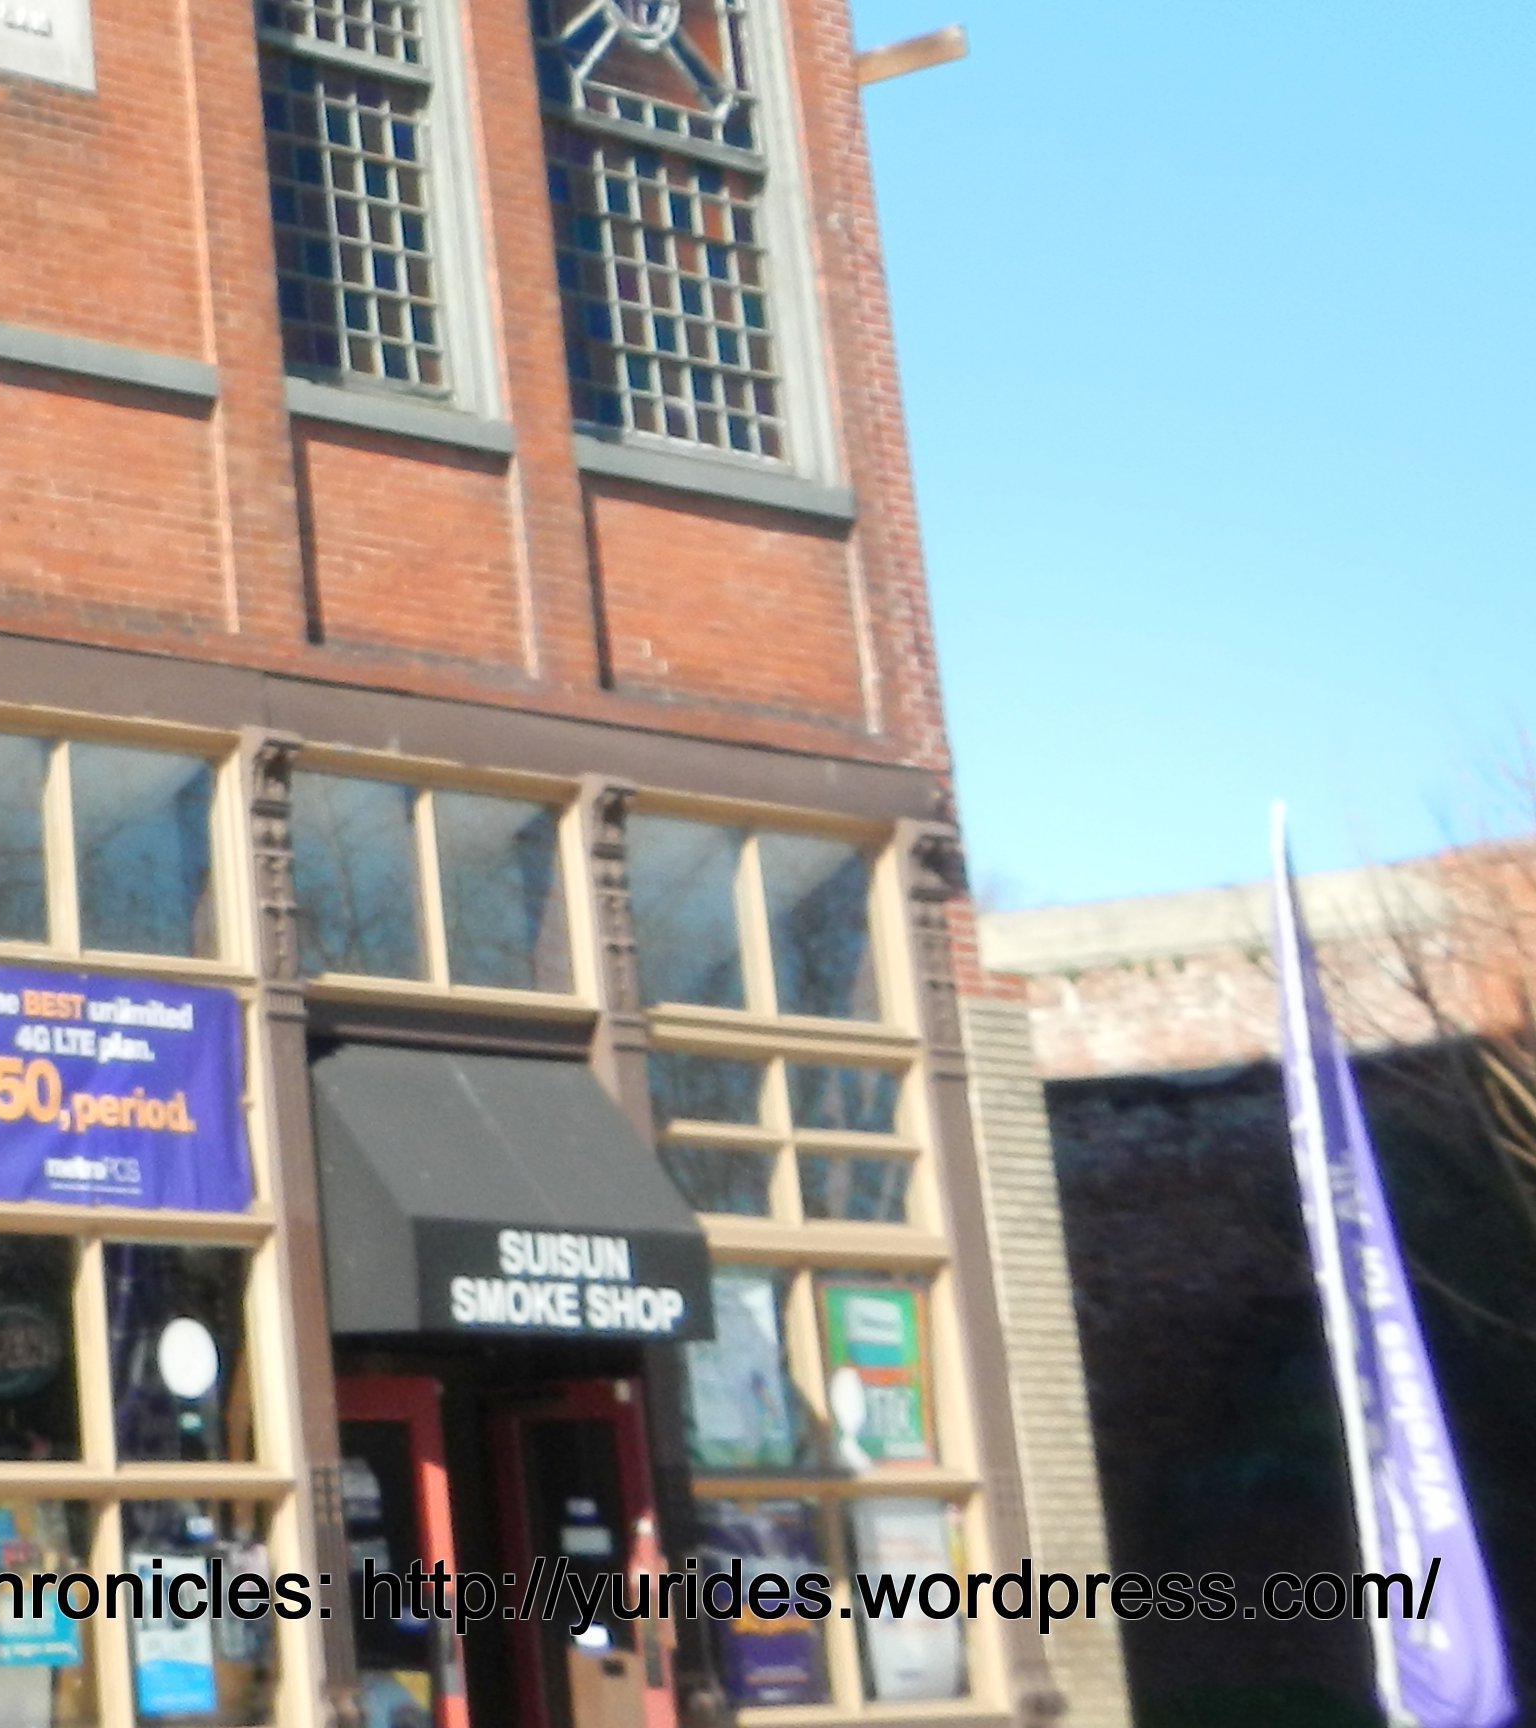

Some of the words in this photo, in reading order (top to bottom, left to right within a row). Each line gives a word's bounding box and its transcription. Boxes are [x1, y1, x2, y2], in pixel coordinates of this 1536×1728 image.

[22, 988, 85, 1019] BEST
[87, 996, 194, 1031] unlimited
[14, 1024, 51, 1053] 4G
[52, 1026, 96, 1057] LTE
[97, 1030, 155, 1064] plan.
[71, 1087, 197, 1133] period.
[498, 1229, 631, 1280] SUISUN
[450, 1275, 581, 1328] SMOKE
[585, 1283, 684, 1332] SHOP
